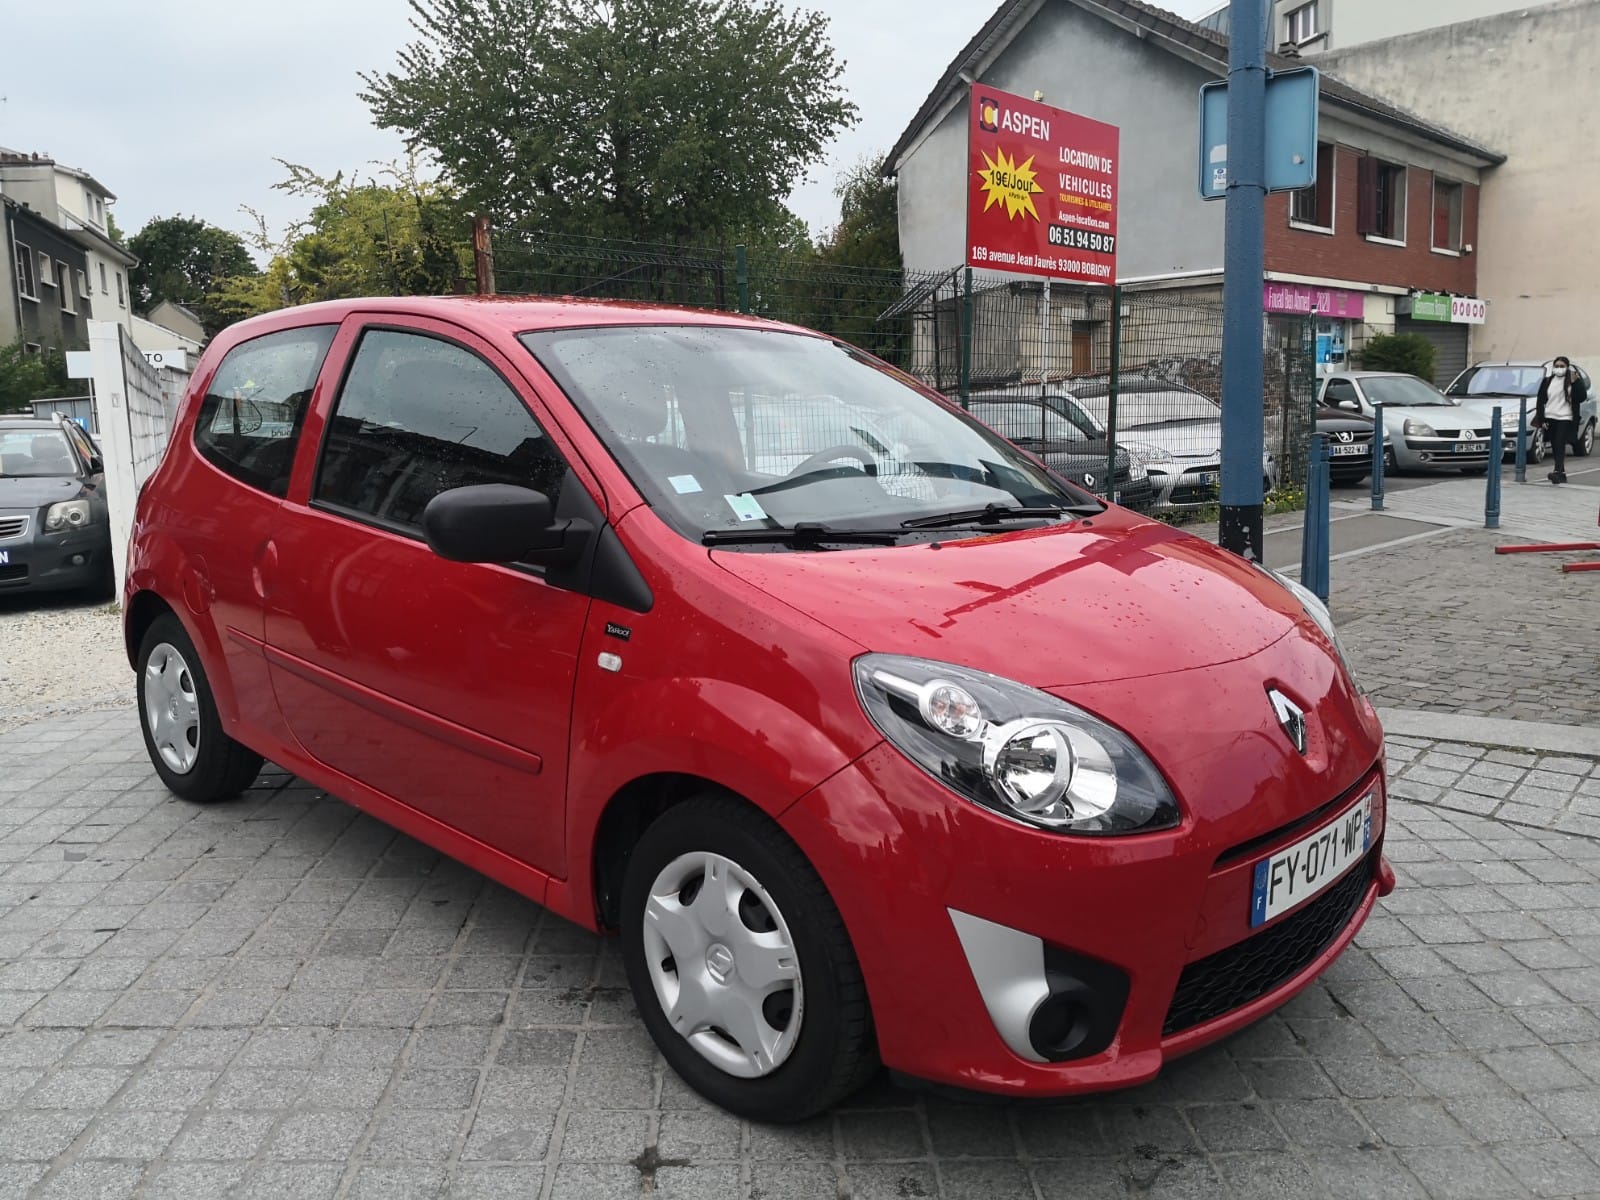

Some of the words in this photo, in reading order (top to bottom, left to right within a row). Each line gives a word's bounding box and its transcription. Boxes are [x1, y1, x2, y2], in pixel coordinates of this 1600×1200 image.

[1002, 110, 1050, 141] ASPEN
[1060, 146, 1100, 172] LOCATION
[1101, 158, 1112, 174] DE
[990, 170, 1034, 192] 19€/Jour
[1059, 174, 1112, 200] VEHICULES
[1059, 211, 1110, 230] Aspen-location.com
[1049, 226, 1062, 244] 06
[1064, 229, 1074, 246] 51
[1077, 231, 1088, 248] 94
[1090, 234, 1102, 250] 50
[1103, 236, 1114, 252] 87
[972, 246, 987, 260] 169
[989, 251, 1015, 262] avenue
[1016, 252, 1033, 266] Jean
[1034, 255, 1056, 269] Jaurès
[1058, 259, 1080, 272] 93000
[1081, 262, 1111, 278] BOBIGNY
[1257, 896, 1262, 910] F
[1269, 809, 1362, 905] FY-071-WP
